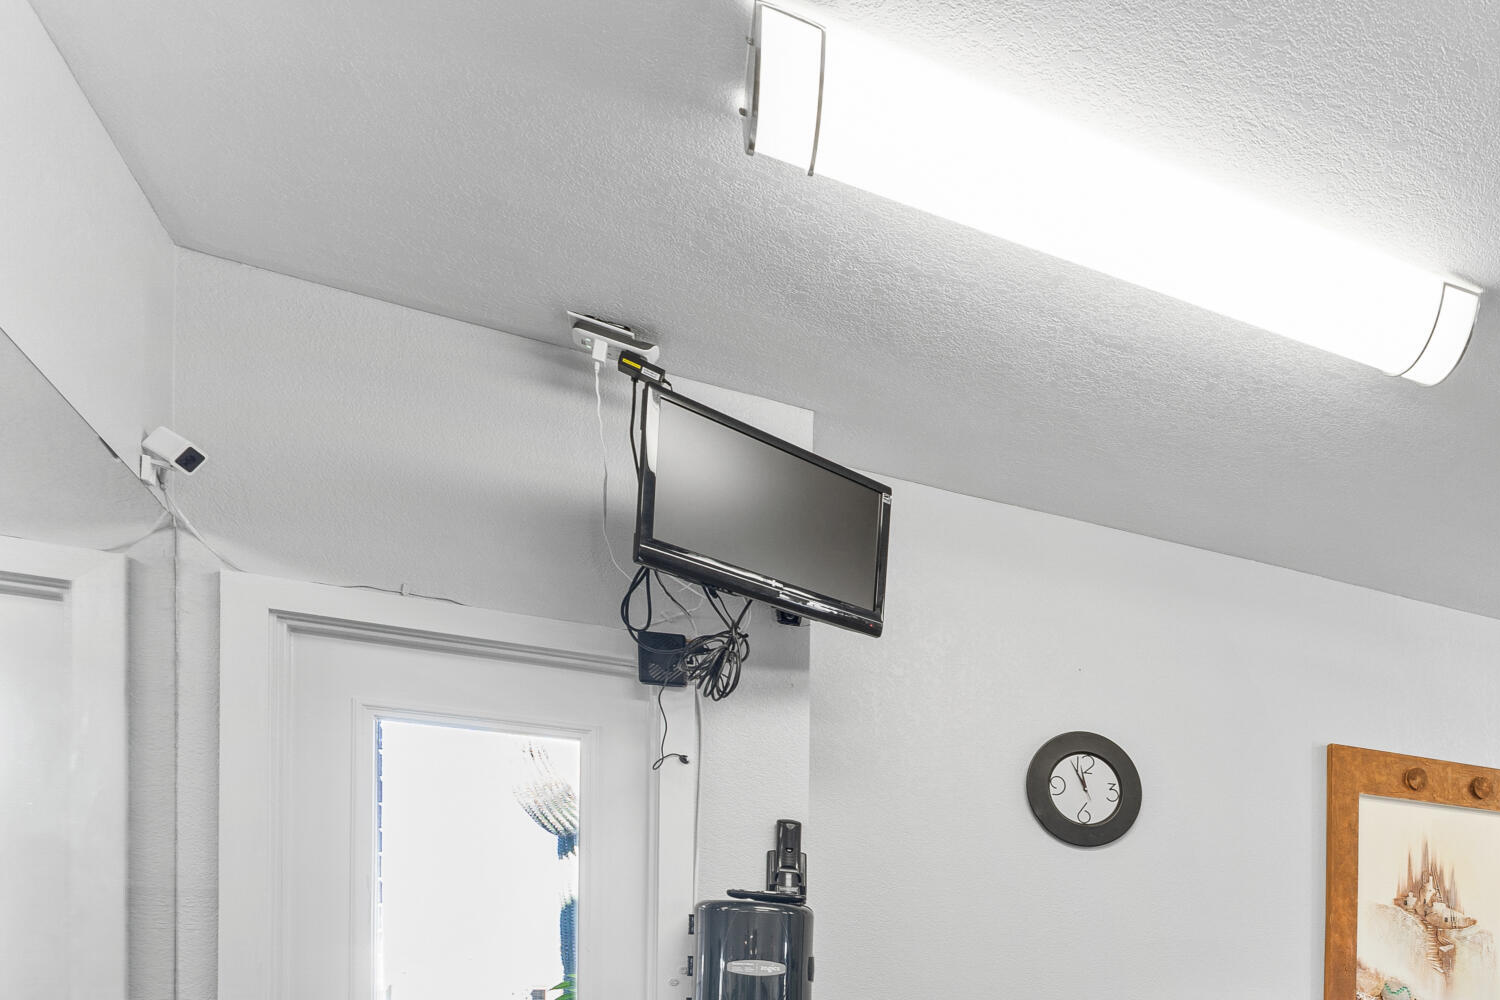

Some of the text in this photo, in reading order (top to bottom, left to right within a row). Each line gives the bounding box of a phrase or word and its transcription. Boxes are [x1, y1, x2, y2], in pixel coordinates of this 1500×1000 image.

[1076, 755, 1095, 775] 12
[1050, 775, 1066, 795] 9
[1106, 783, 1120, 802] 3
[1077, 802, 1091, 824] 6
